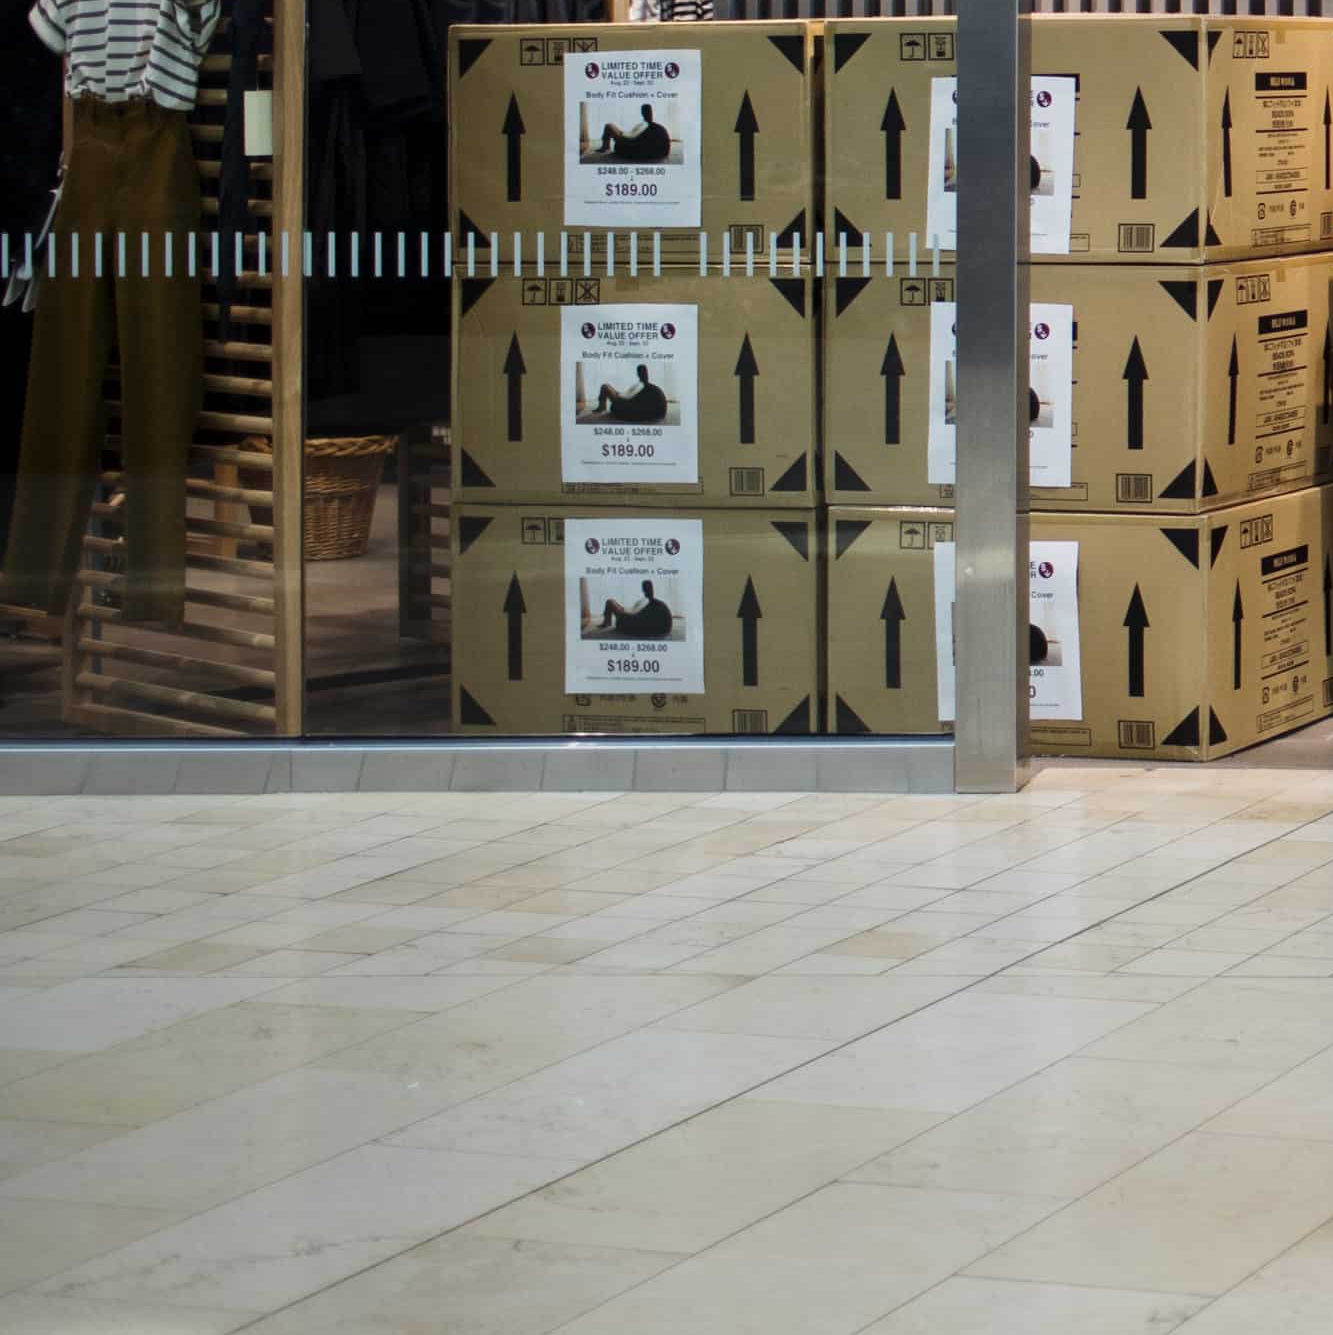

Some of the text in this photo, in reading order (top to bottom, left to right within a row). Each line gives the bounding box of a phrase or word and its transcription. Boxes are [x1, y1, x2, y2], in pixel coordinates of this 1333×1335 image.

[601, 62, 663, 70] LIMITED TIME
[601, 71, 663, 79] VALUE OFFER
[606, 183, 658, 197] $189.00
[597, 322, 658, 331] LIMITED TIME
[597, 331, 658, 340] VALUE OFFER
[601, 444, 655, 457] $189.00
[602, 538, 663, 546] LIMITED TIME
[602, 547, 663, 555] VALUE OFFER
[607, 659, 660, 673] $189.00
